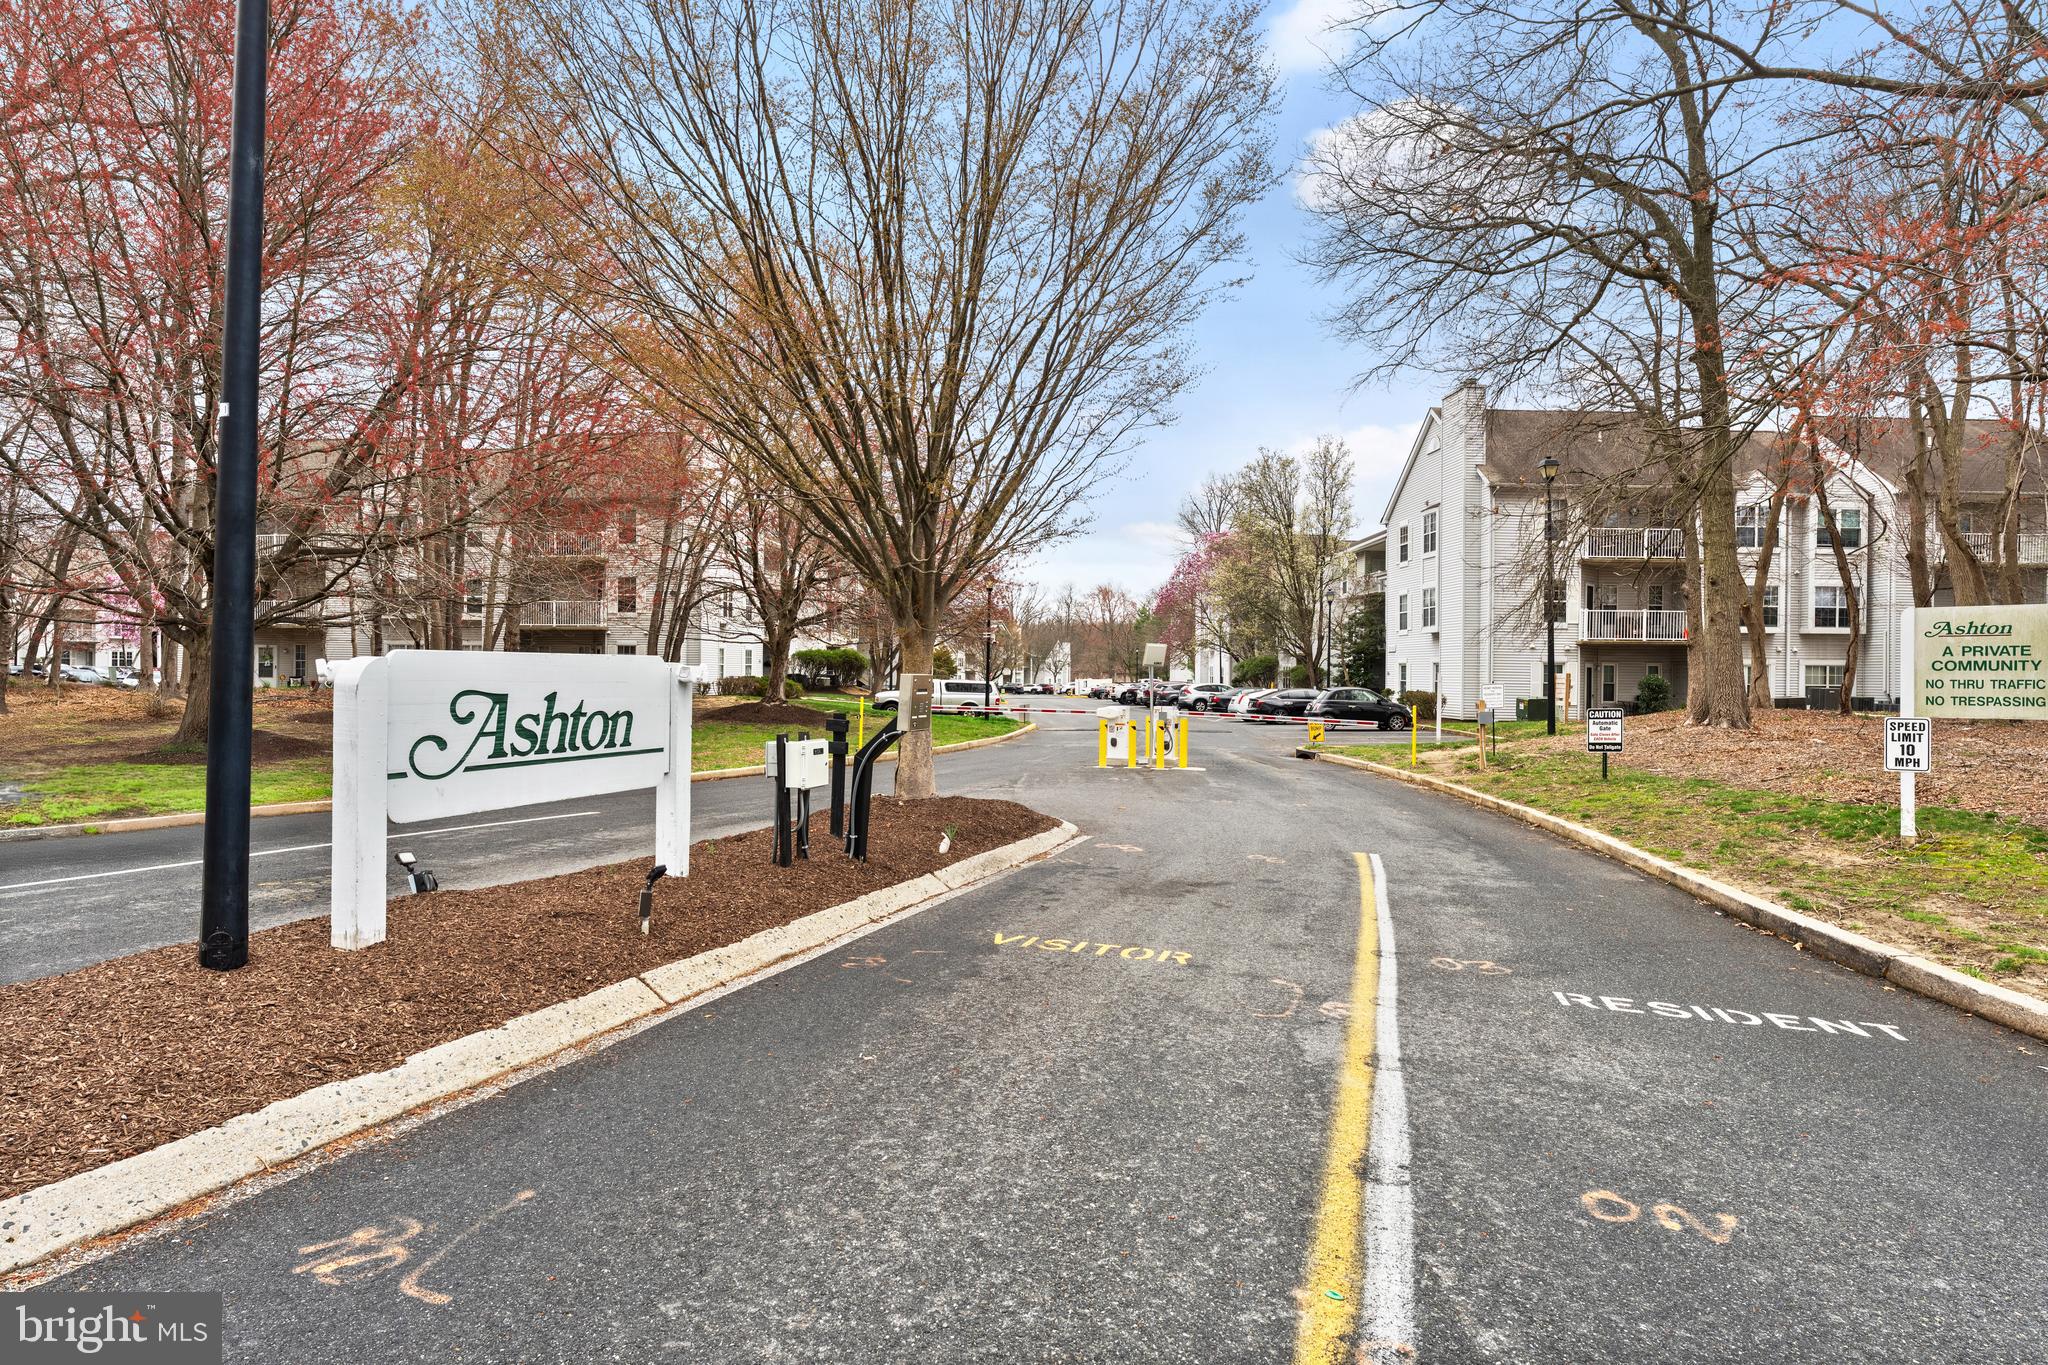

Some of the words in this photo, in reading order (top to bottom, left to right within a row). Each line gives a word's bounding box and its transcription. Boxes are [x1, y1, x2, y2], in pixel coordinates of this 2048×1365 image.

[1924, 621, 2013, 638] Ashton
[1942, 646, 1954, 657] A
[1961, 645, 2032, 657] PRIVATE
[1931, 660, 2042, 672] COMMUNITY
[1925, 679, 1945, 690] NO
[1949, 679, 1985, 690] THRU
[1990, 679, 2046, 690] TRAFFIC
[1925, 695, 1945, 706] NO
[1950, 696, 2046, 707] TRESPASSING
[1889, 722, 1926, 732] SPEED
[408, 689, 634, 780] Ashton
[1891, 732, 1924, 743] LIMIT
[1900, 744, 1915, 756] 10
[1895, 757, 1920, 768] MPH
[993, 933, 1193, 966] VISITOR
[1551, 991, 1909, 1042] RESIDENT
